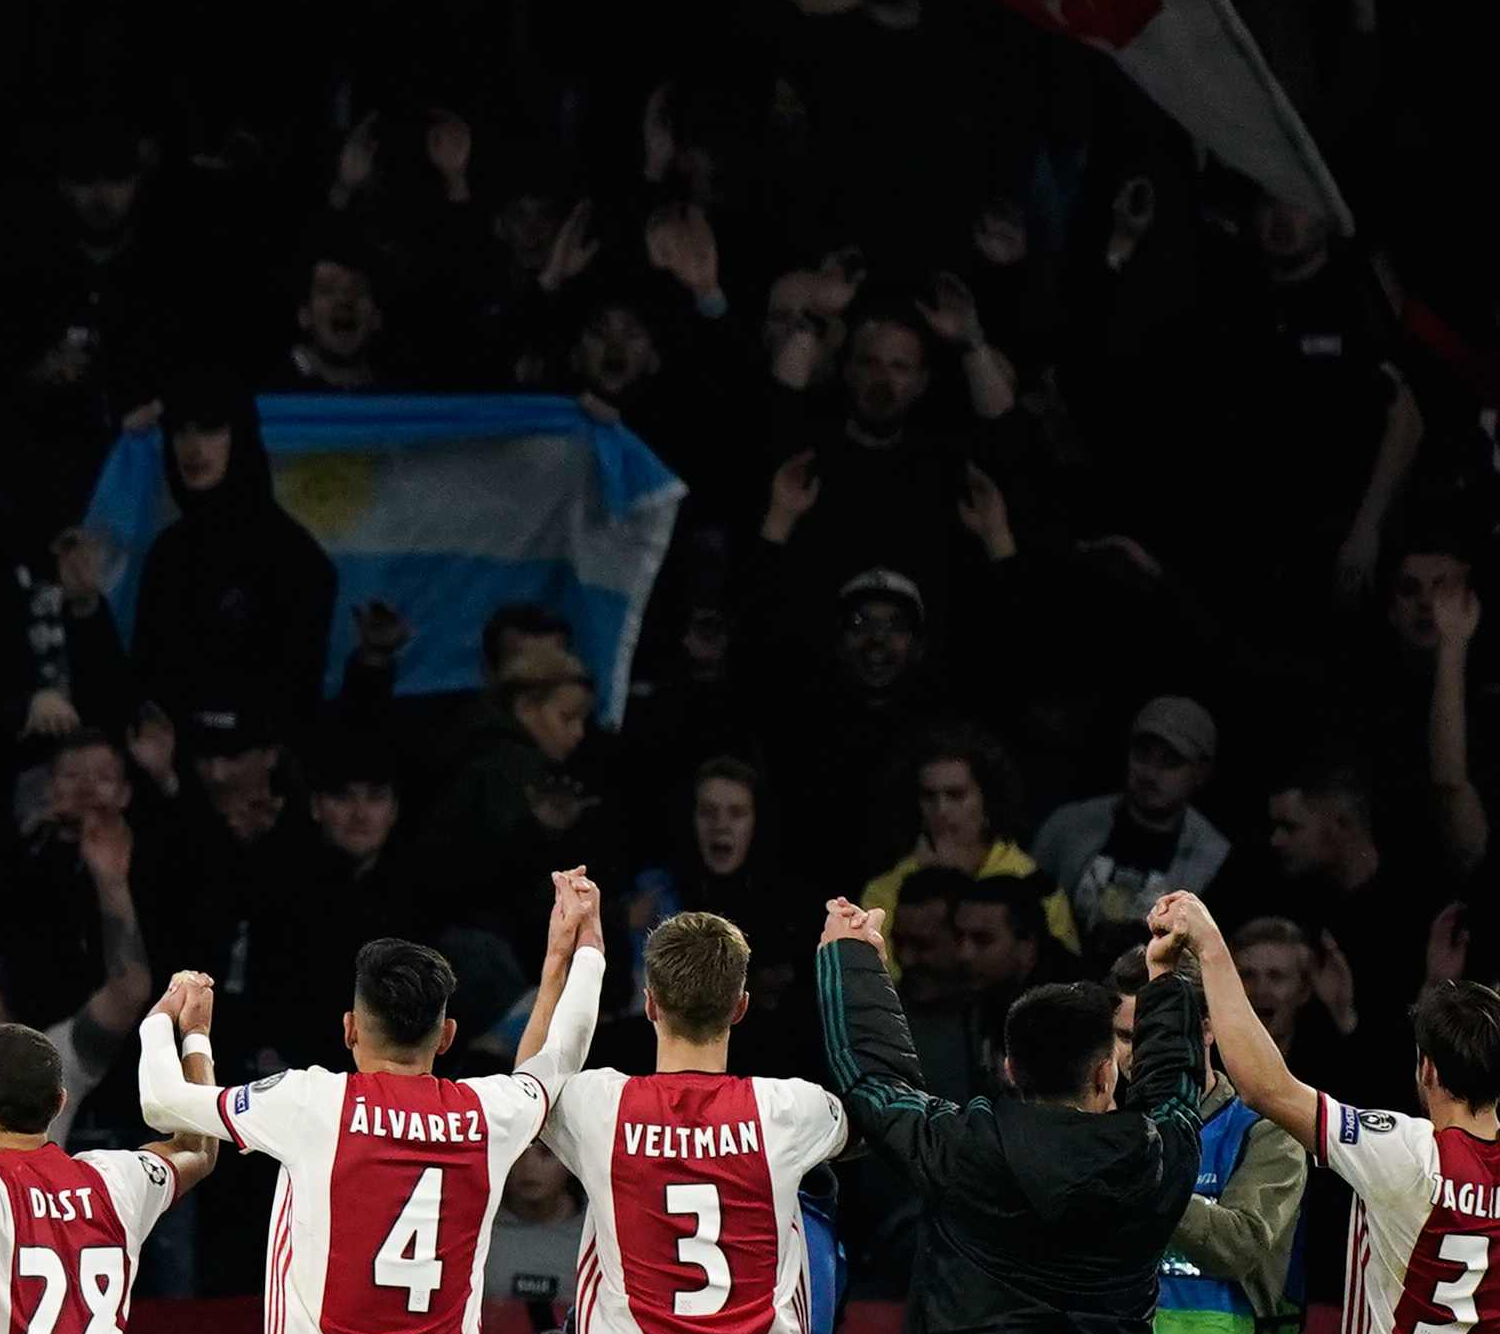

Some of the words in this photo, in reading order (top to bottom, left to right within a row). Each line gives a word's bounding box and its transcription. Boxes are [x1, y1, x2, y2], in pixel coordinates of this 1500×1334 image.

[349, 1095, 483, 1144] ÁLVAREZ
[623, 1120, 760, 1160] VELTMAN
[373, 1166, 444, 1314] 4
[665, 1183, 733, 1316] 3
